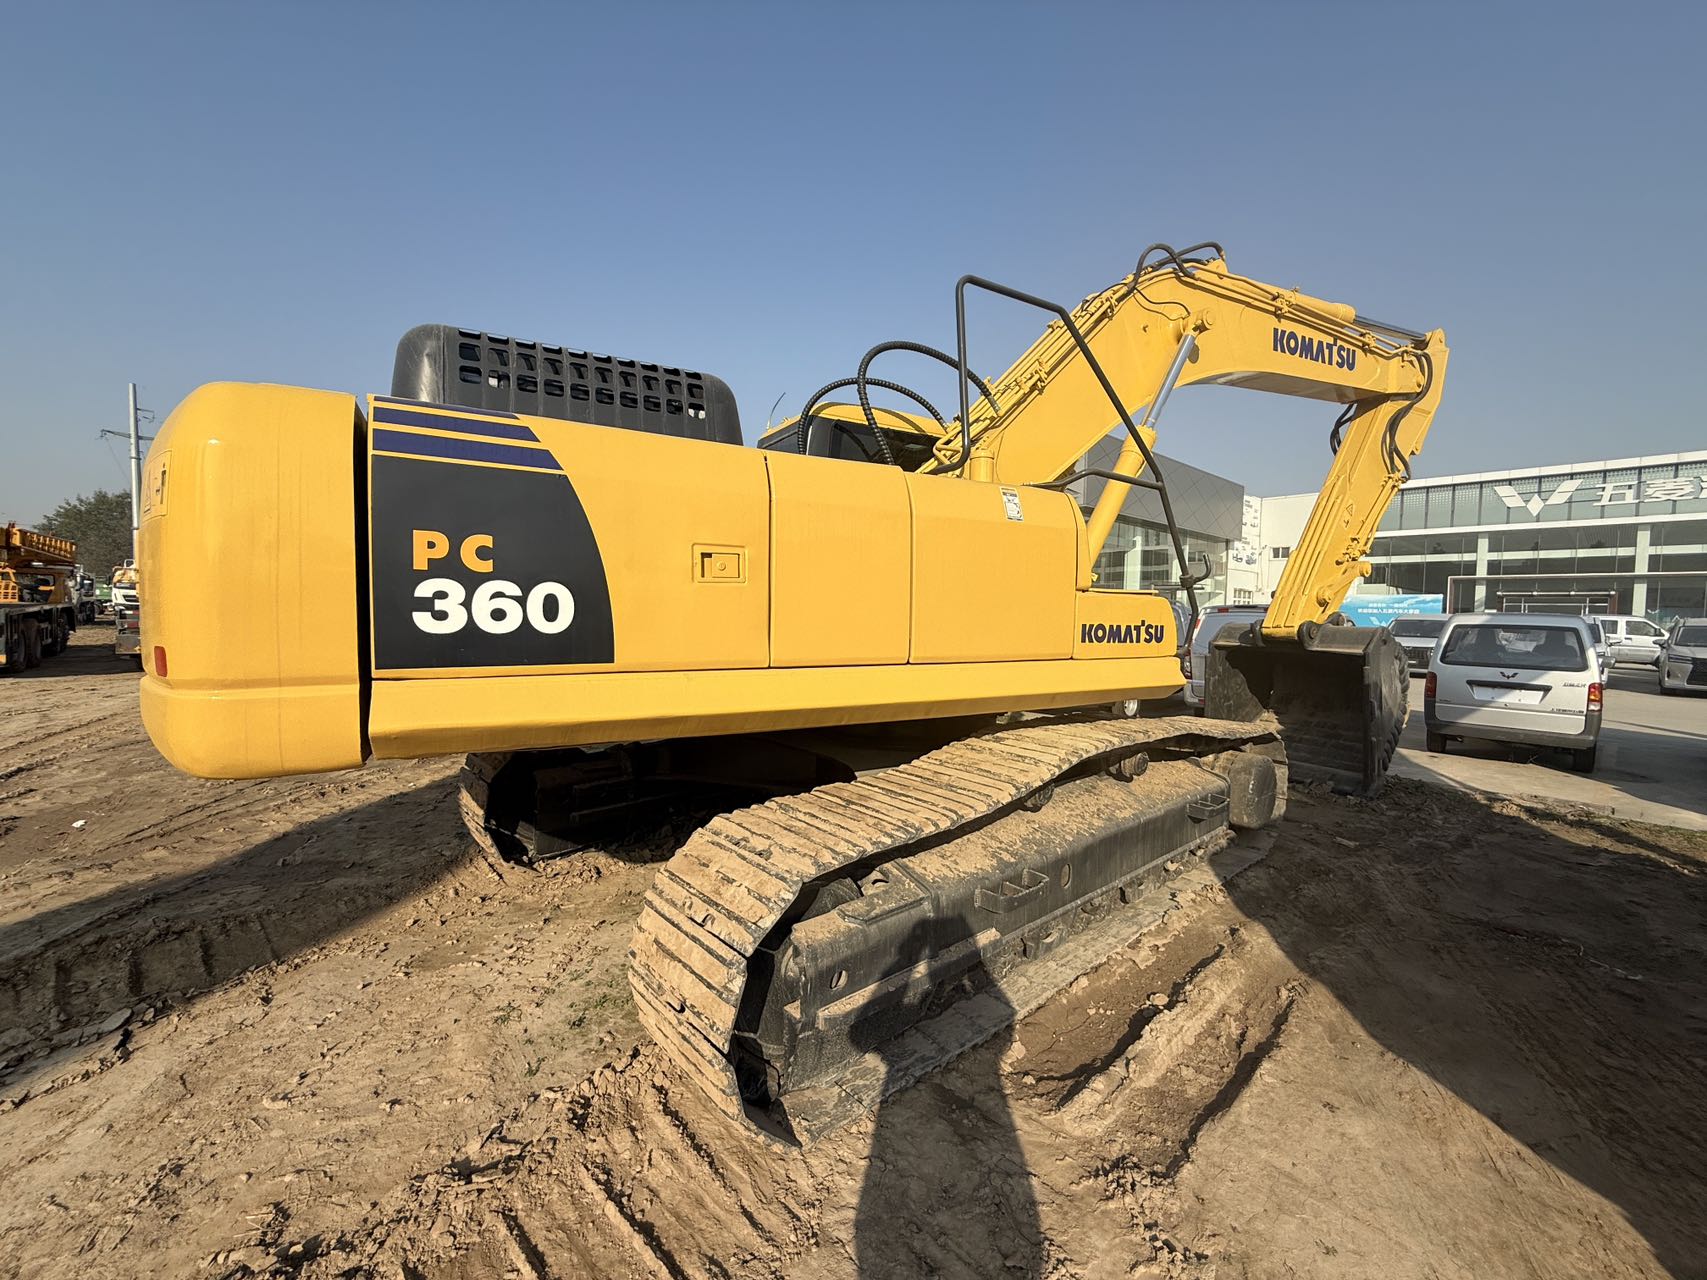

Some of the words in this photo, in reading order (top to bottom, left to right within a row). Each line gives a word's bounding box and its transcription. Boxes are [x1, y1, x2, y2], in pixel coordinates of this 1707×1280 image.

[1273, 327, 1356, 371] KOMATSU
[1593, 476, 1707, 507] 五菱
[411, 577, 575, 635] 360
[1081, 620, 1164, 643] KOMATSU
